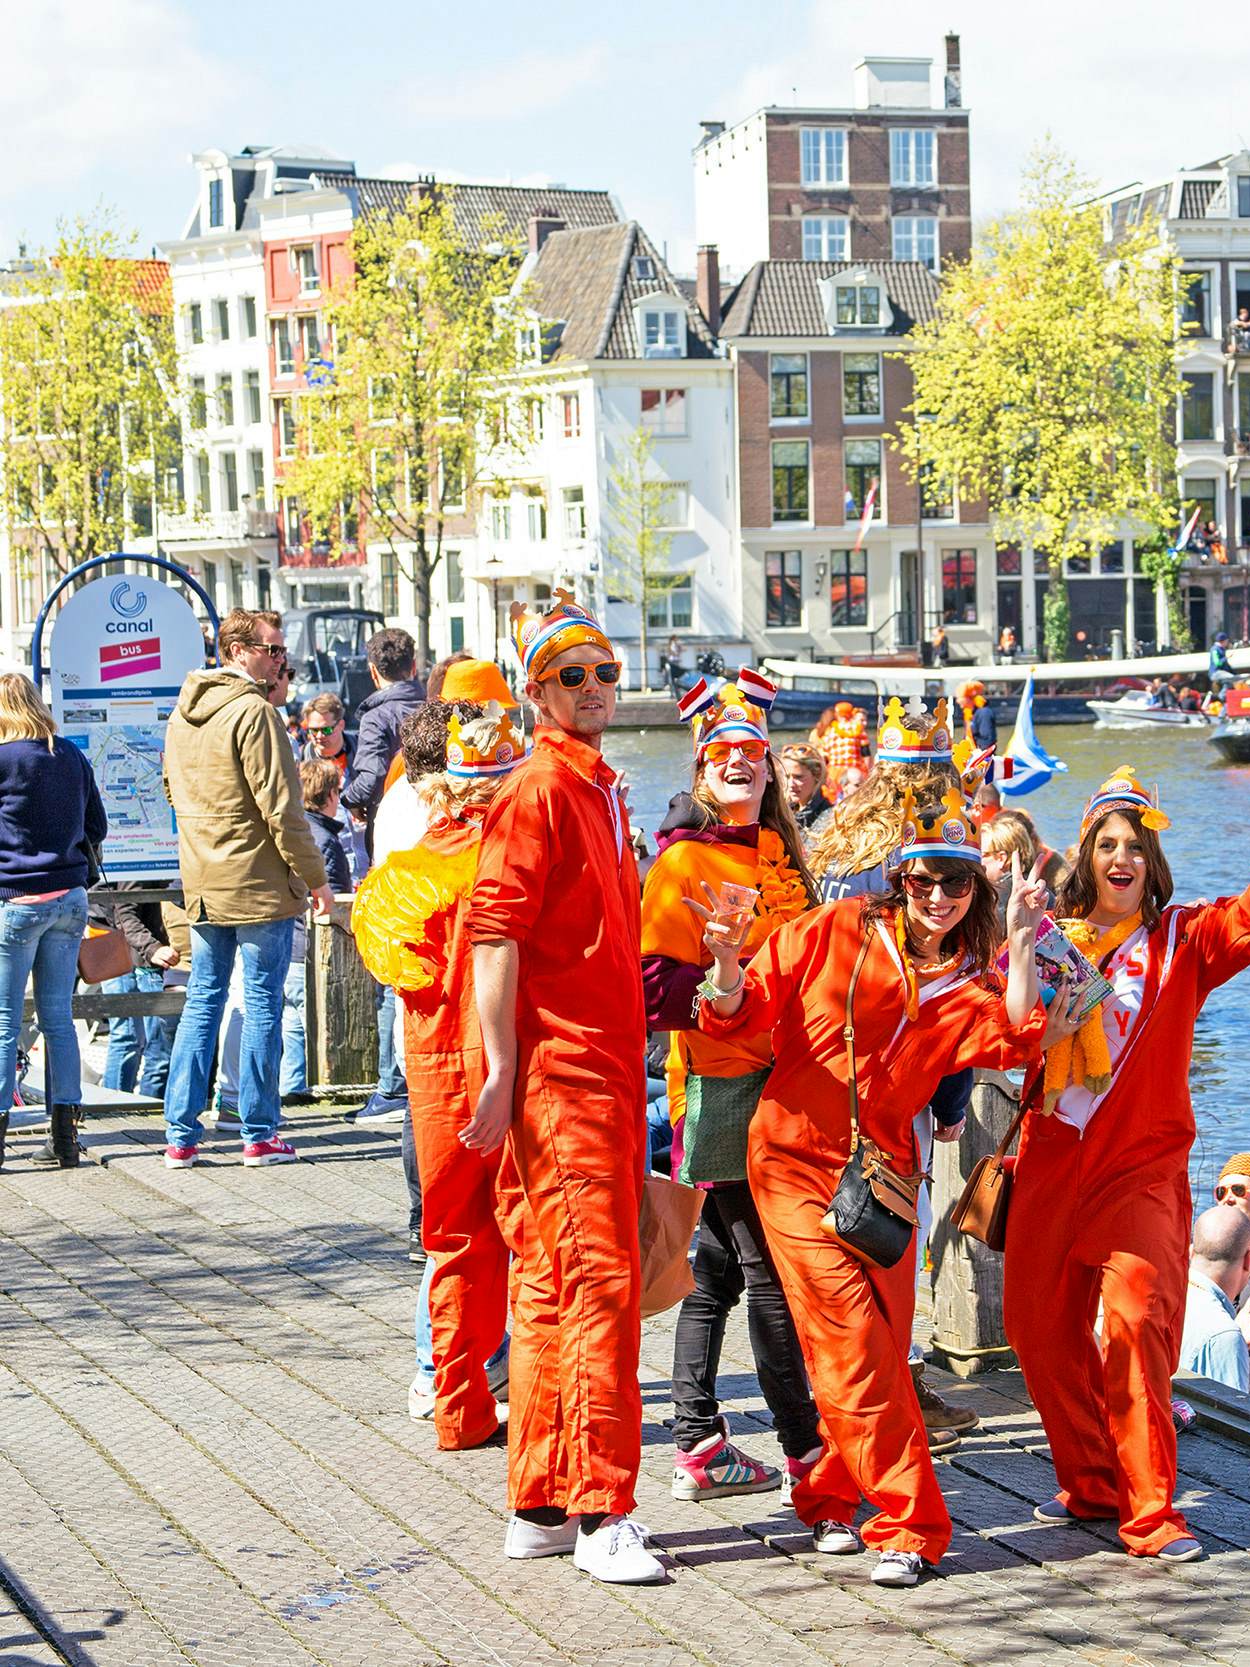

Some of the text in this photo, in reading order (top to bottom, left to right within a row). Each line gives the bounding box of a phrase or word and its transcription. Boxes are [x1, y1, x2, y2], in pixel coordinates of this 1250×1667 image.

[105, 618, 153, 633] canal
[119, 645, 142, 656] bus
[946, 829, 964, 838] KING
